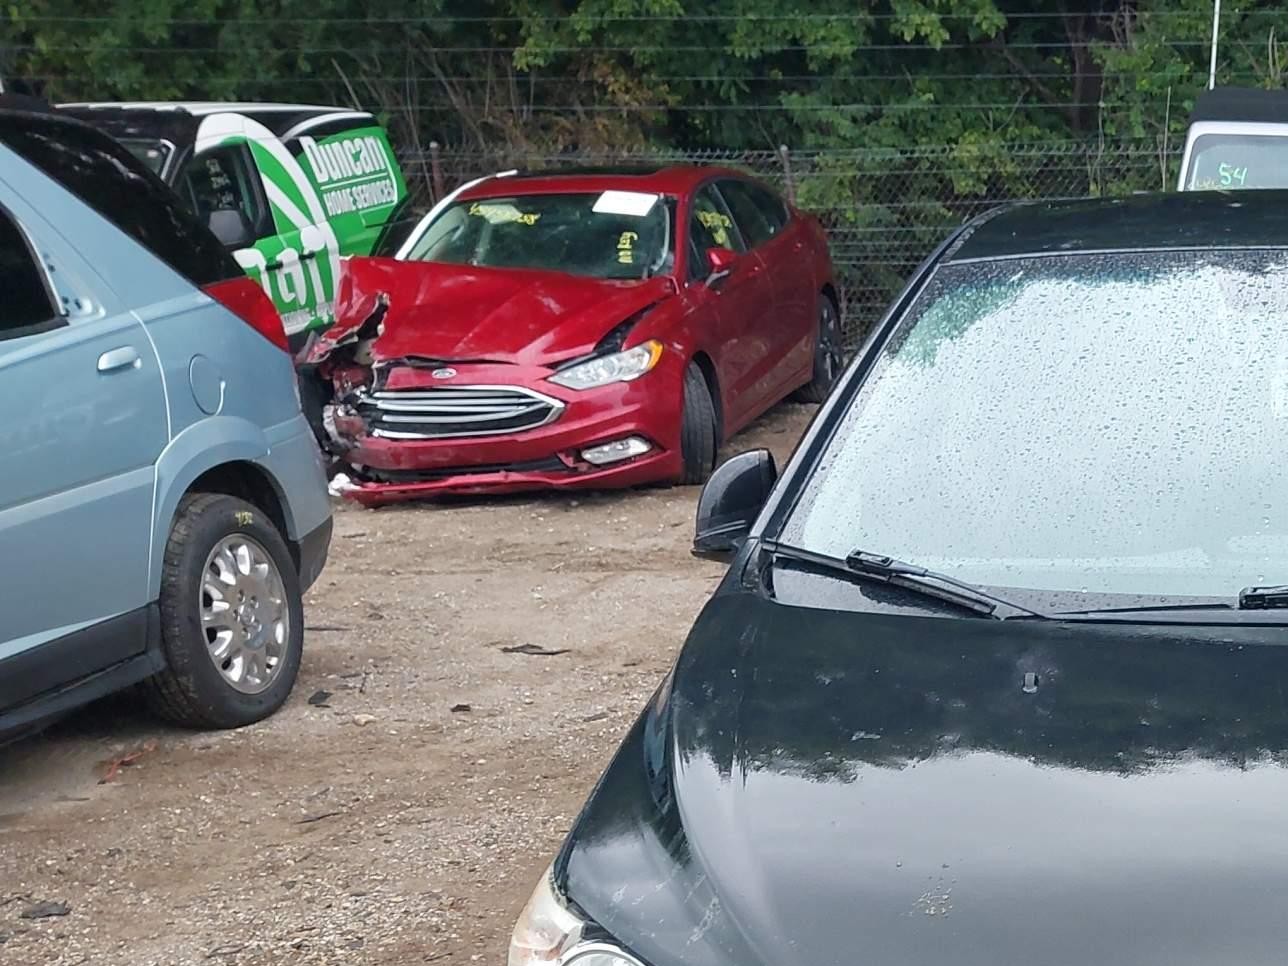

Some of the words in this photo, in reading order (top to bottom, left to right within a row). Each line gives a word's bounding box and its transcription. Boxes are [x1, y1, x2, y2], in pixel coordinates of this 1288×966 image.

[299, 136, 386, 183] Duncan
[1218, 162, 1248, 186] 54
[323, 187, 356, 216] HOME
[352, 179, 395, 209] SERVICES
